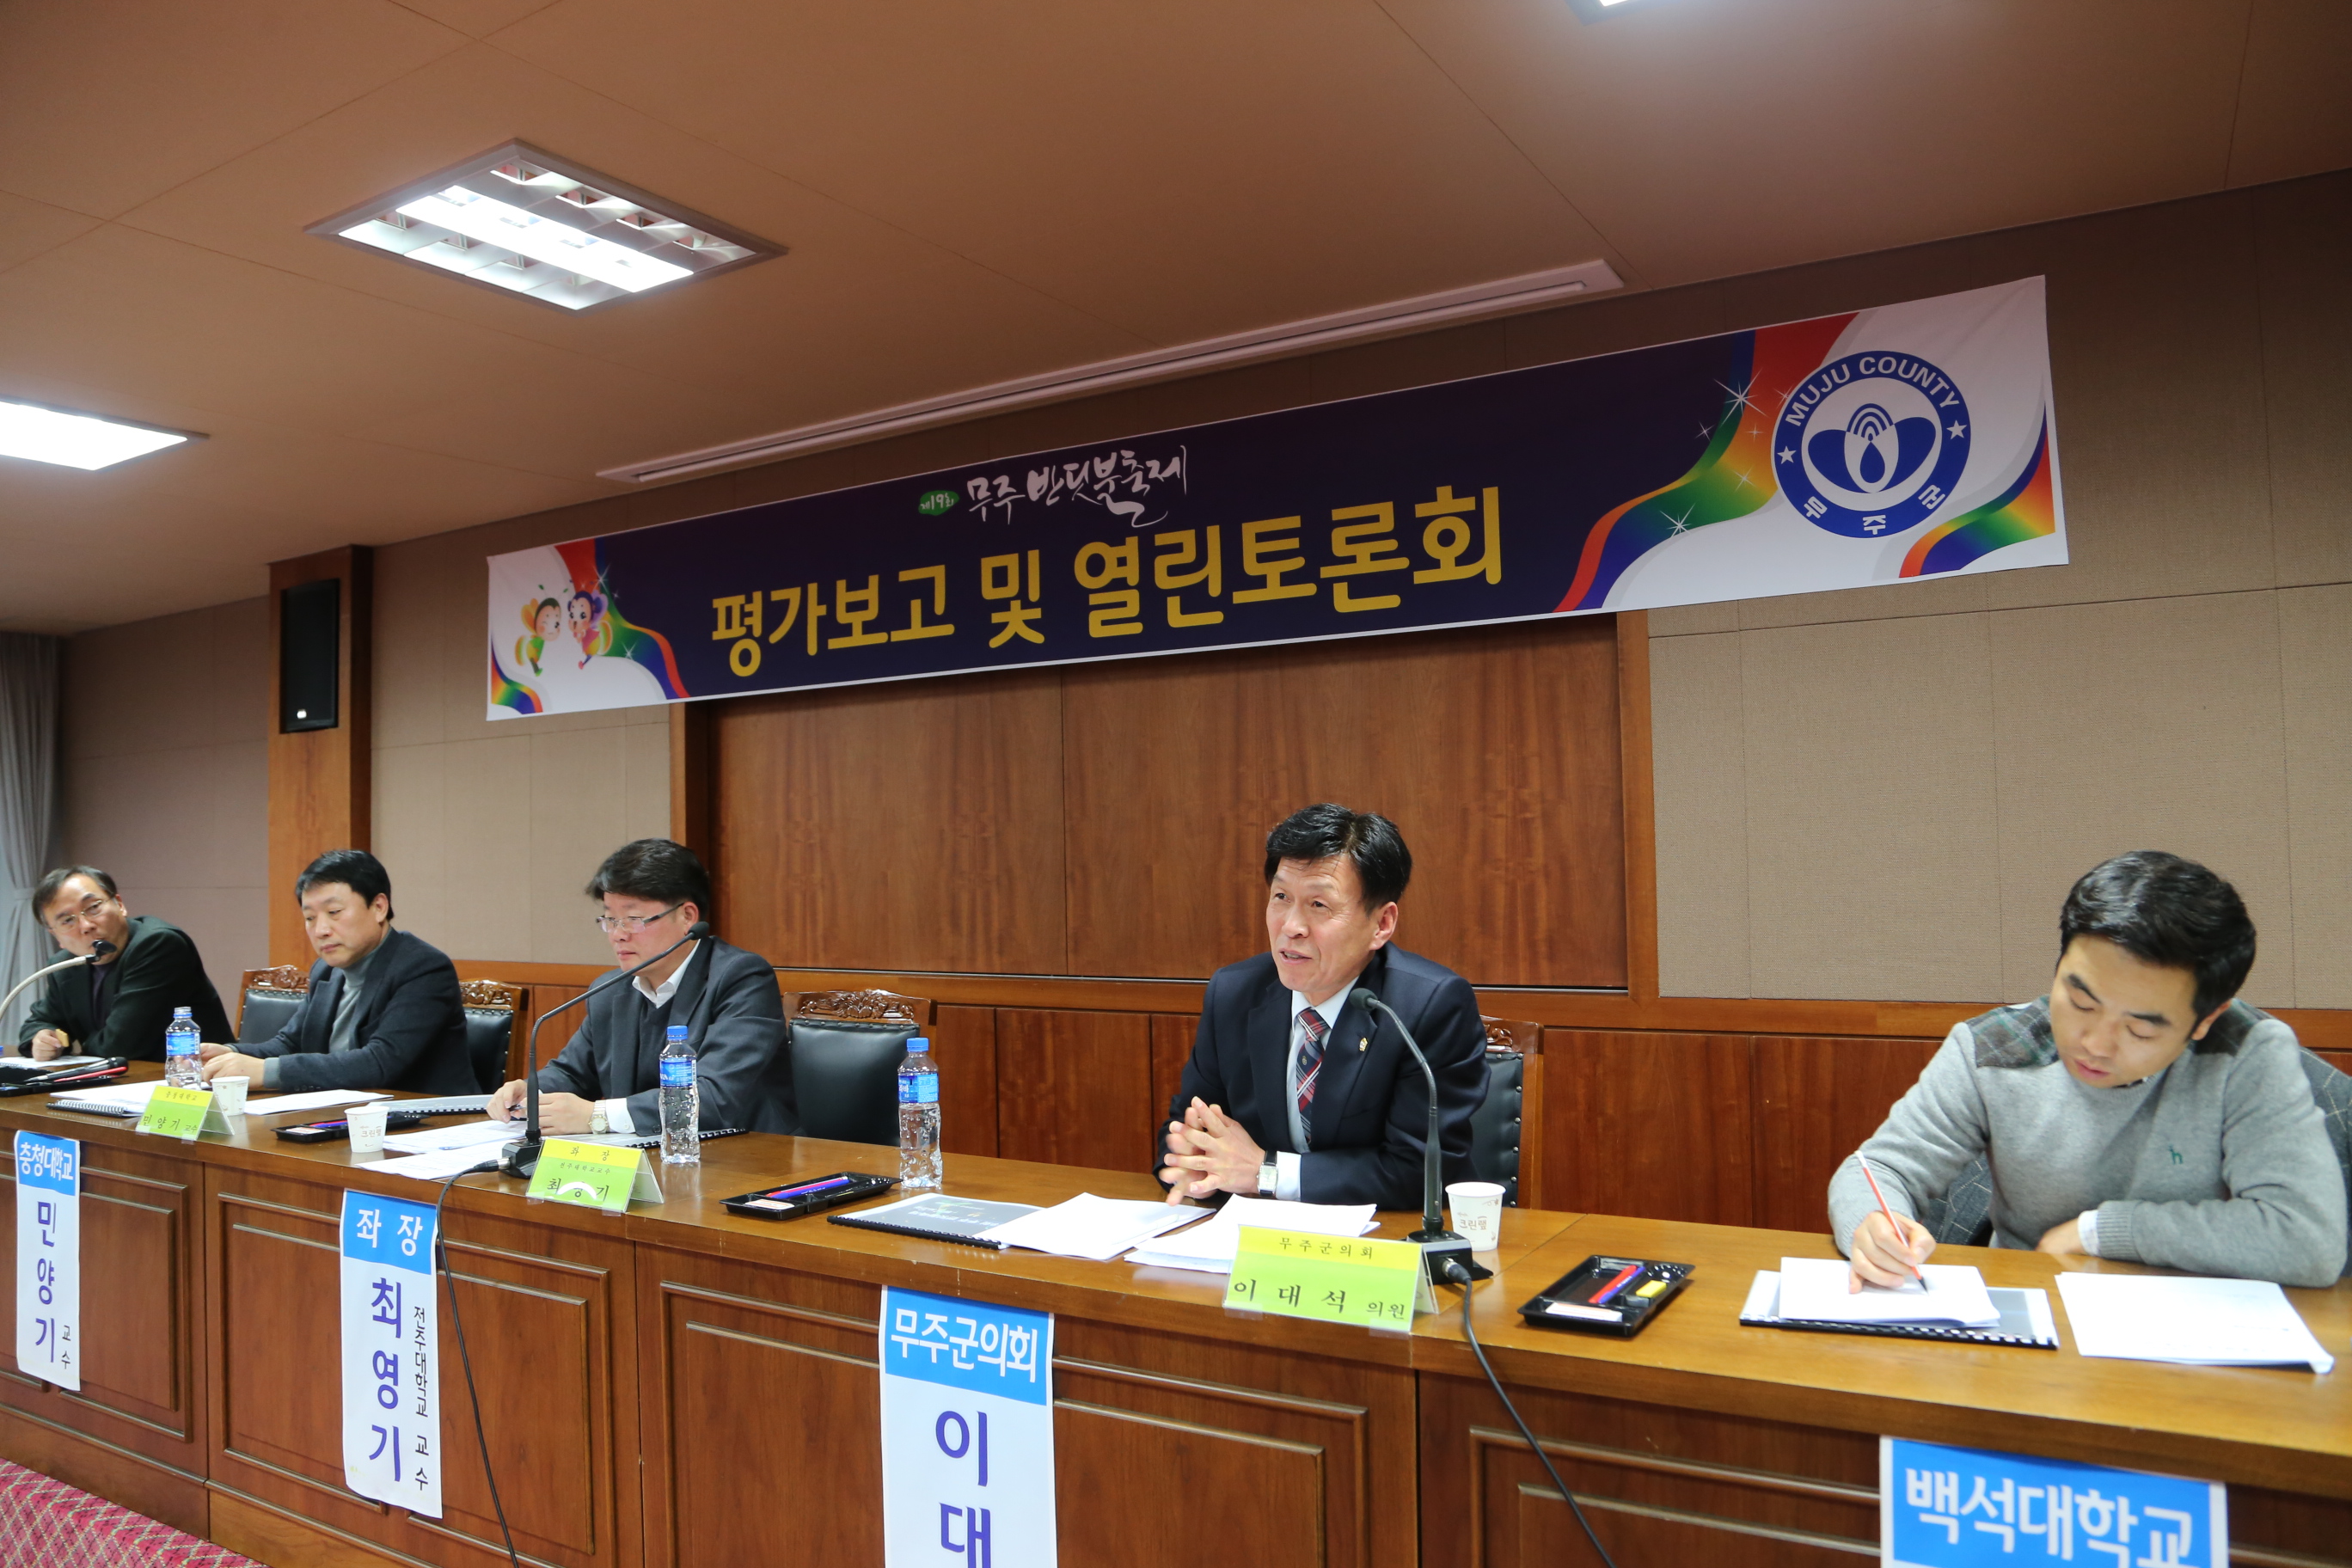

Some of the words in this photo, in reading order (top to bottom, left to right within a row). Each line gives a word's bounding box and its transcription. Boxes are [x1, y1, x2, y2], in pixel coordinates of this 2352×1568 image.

[1785, 364, 1851, 427] MUJU
[1859, 356, 1960, 408] COUNTY
[920, 492, 954, 511] 제19회
[967, 475, 1026, 525] 무주
[712, 564, 955, 677] 평가보고
[980, 548, 1045, 649] 및
[1074, 485, 1502, 639] 열린토론회
[18, 1142, 74, 1182] 충청대학교
[1279, 1237, 1373, 1259] 무주군의회
[891, 1308, 1038, 1384] 무주군의회
[1366, 1302, 1405, 1320] 의원
[413, 1305, 429, 1418] 전주대학교
[1904, 1467, 2202, 1568] 백석대학교
